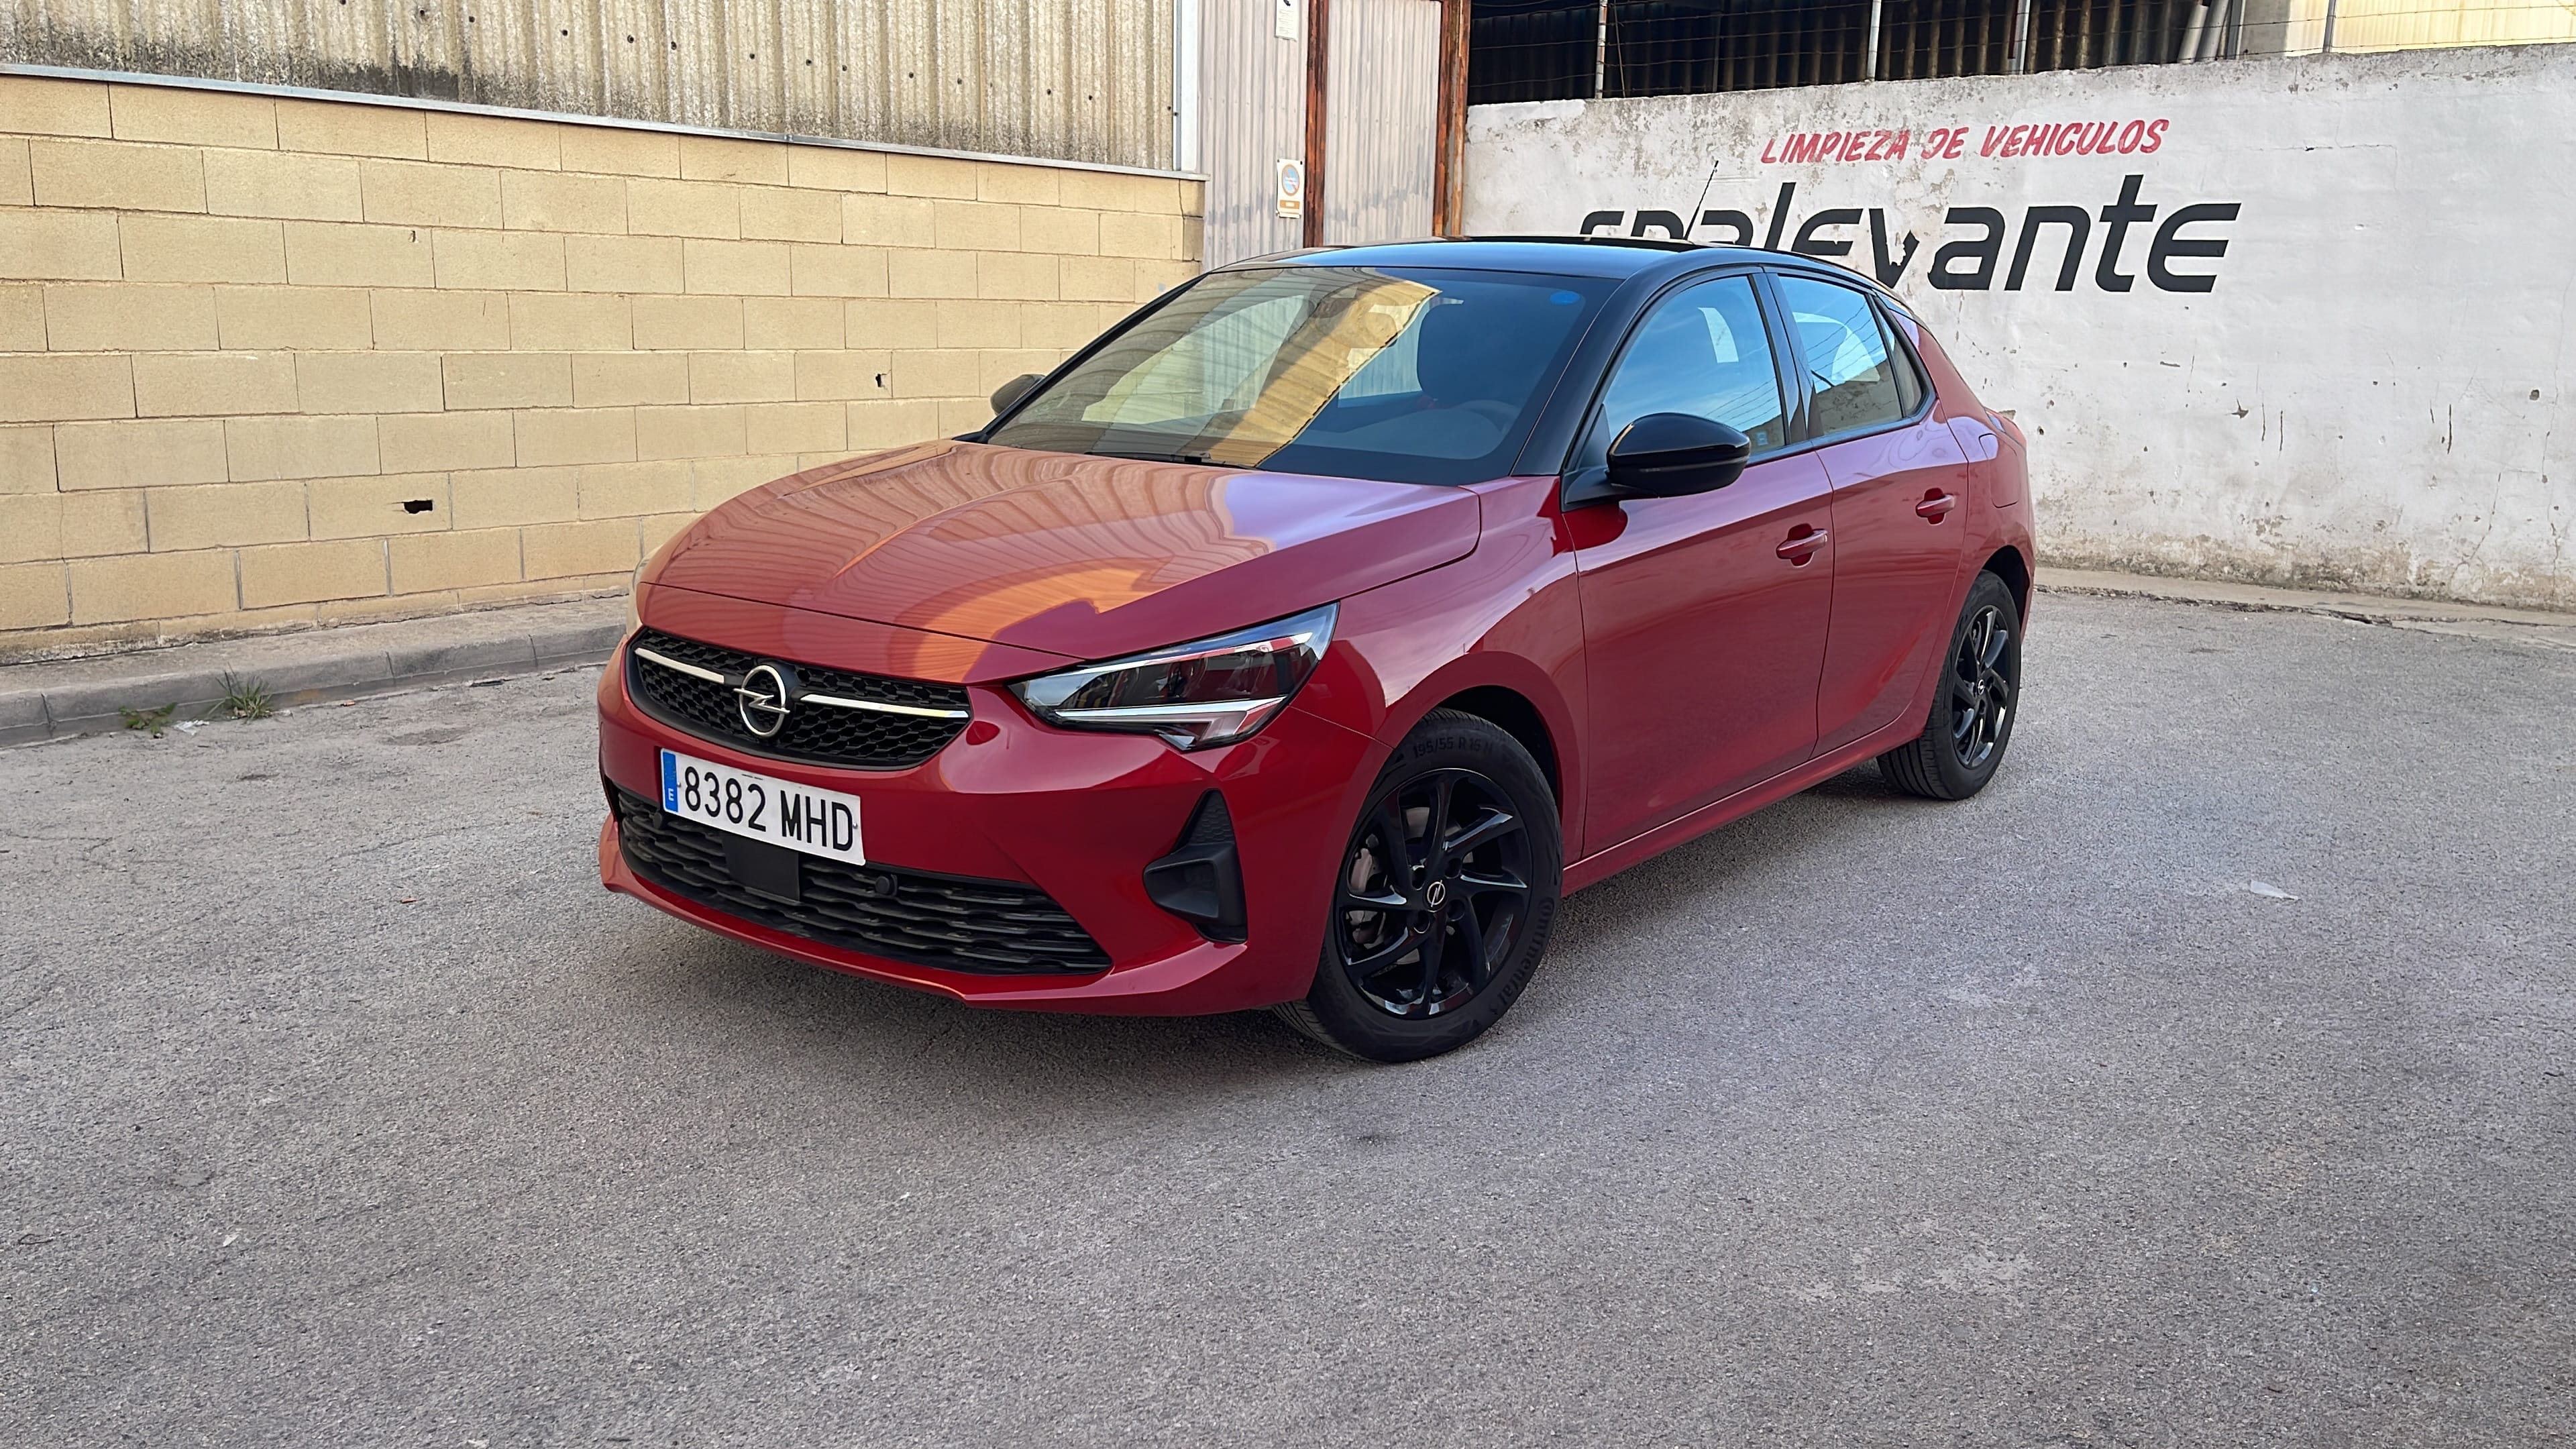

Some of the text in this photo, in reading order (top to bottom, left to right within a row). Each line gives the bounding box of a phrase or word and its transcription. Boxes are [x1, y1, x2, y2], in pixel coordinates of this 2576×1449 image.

[1761, 119, 2170, 164] LIMPIEZA DE VEHICULOS
[1579, 174, 2242, 293] levante
[1413, 737, 1454, 759] 195/55
[667, 788, 674, 802] E
[684, 766, 854, 851] 8382 MHD
